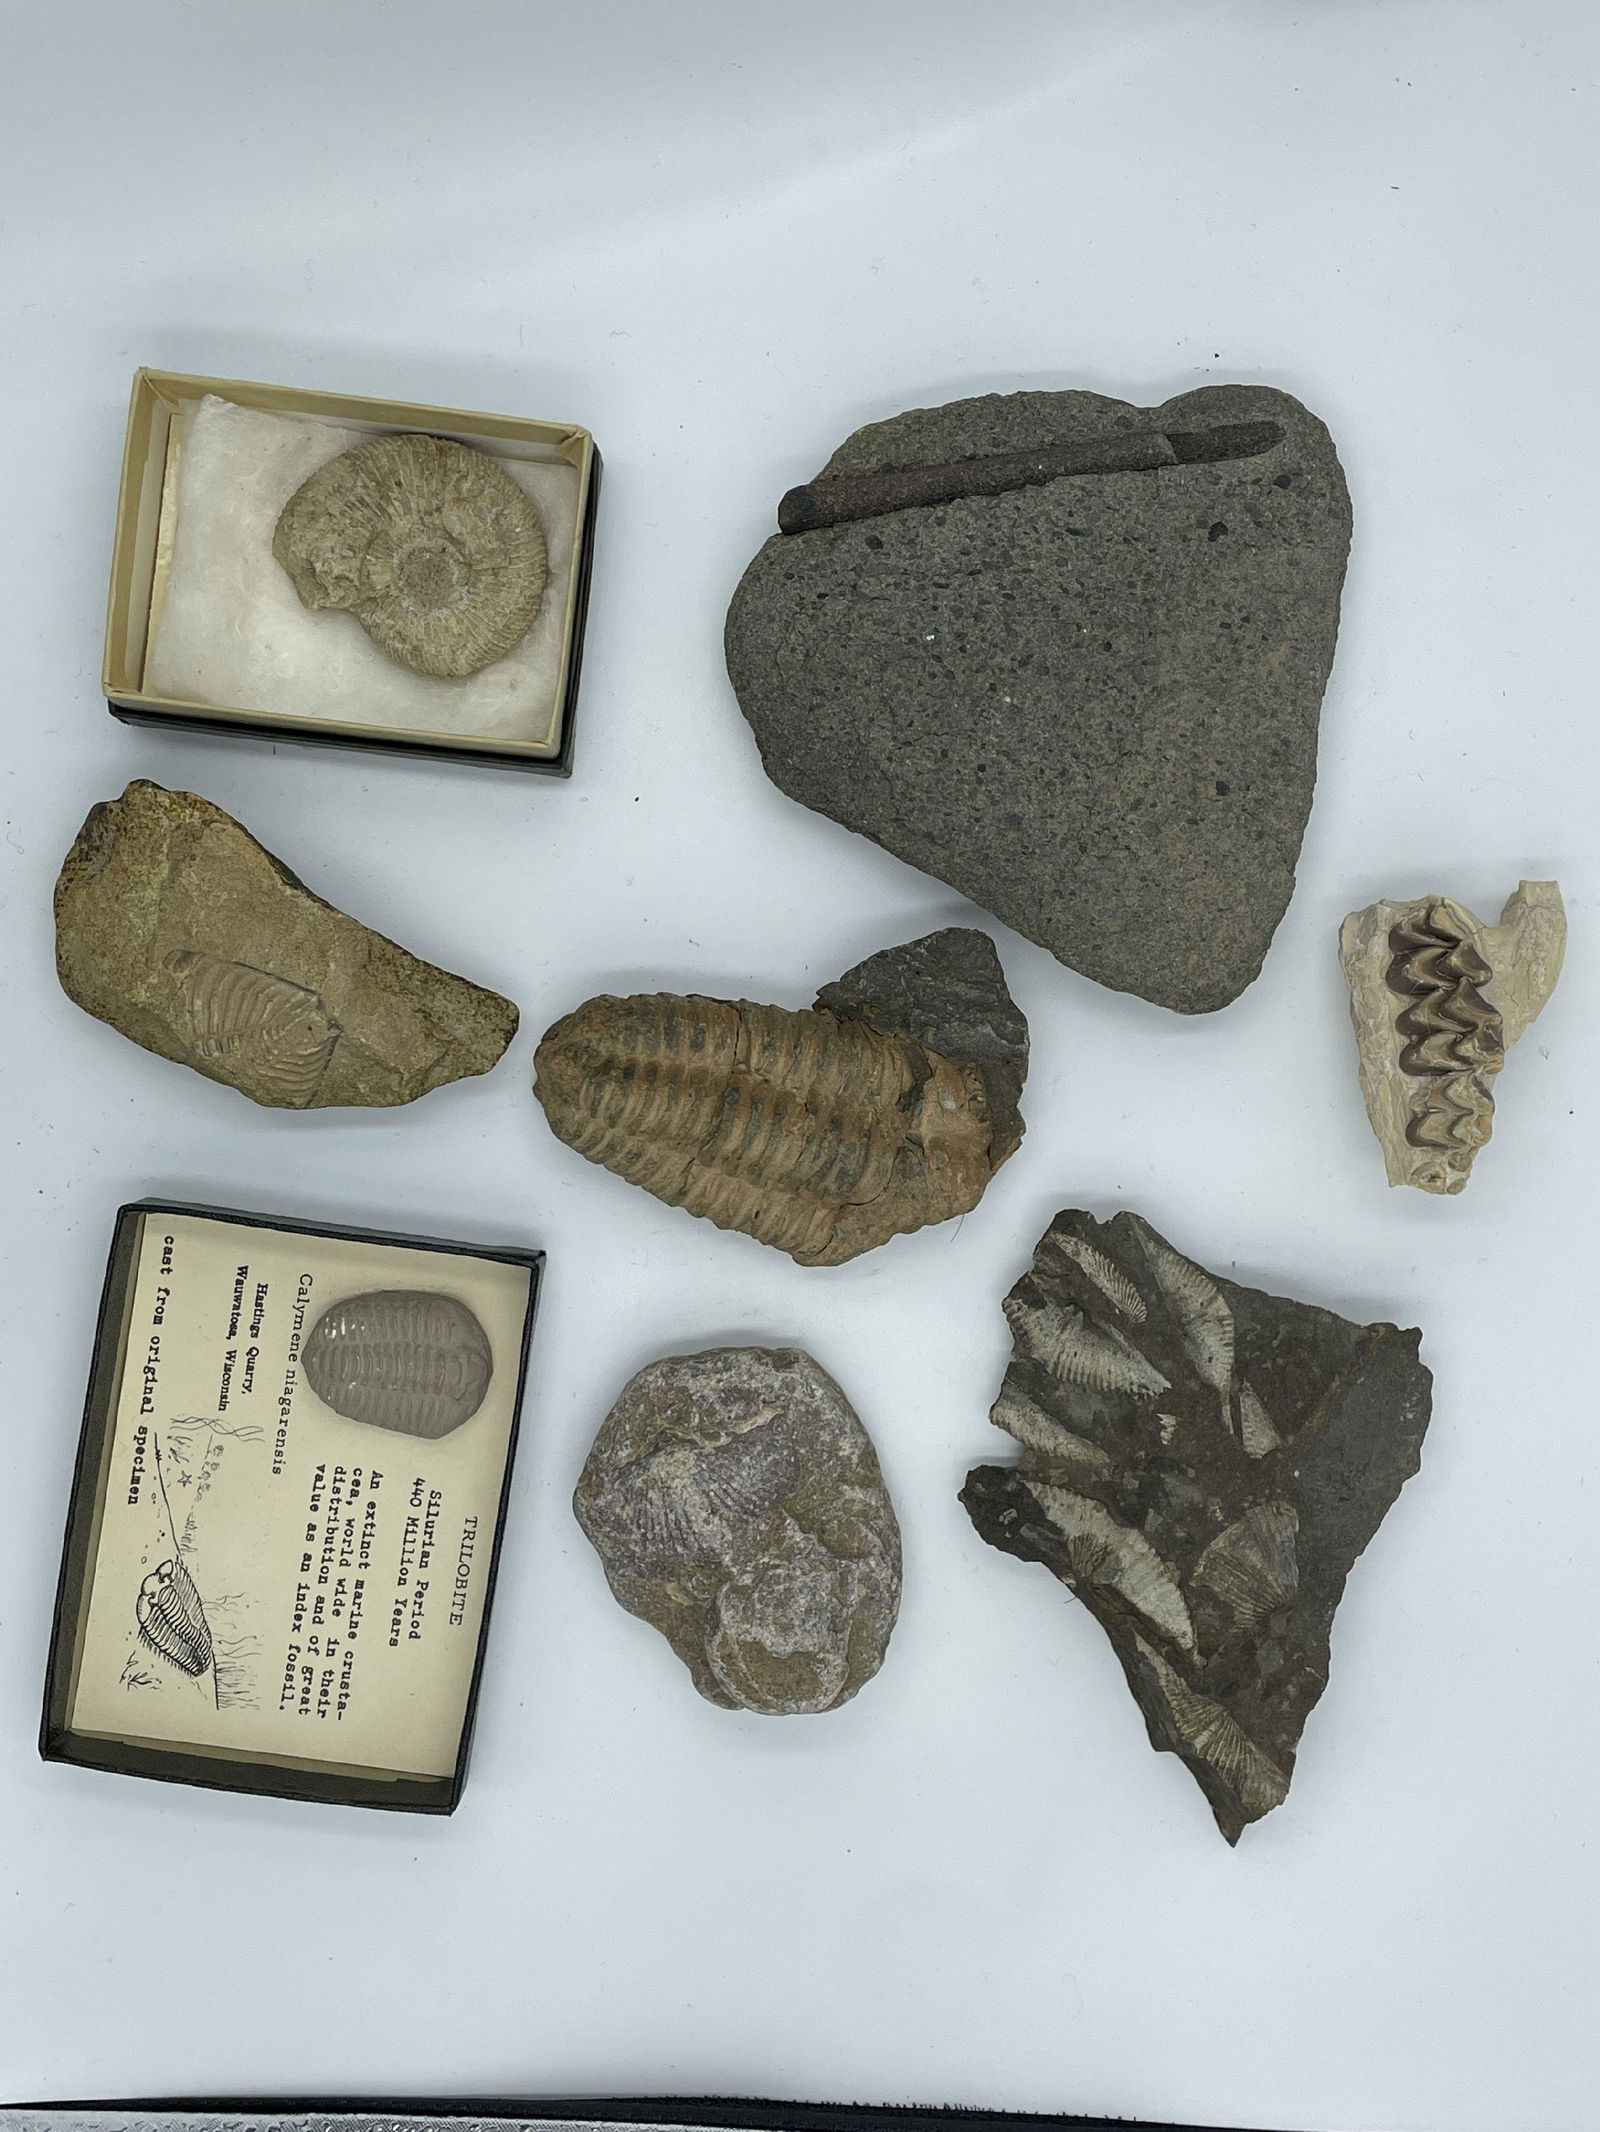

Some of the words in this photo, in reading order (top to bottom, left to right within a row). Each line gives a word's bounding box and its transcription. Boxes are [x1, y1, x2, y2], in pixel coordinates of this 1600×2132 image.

[161, 1235, 174, 1275] cast
[153, 1287, 170, 1325] from
[226, 1265, 249, 1340] Wauwatosa,
[250, 1283, 268, 1339] Hastings
[289, 1273, 313, 1362] Calymene
[140, 1336, 160, 1415] original
[218, 1349, 237, 1411] Wisconsin
[241, 1347, 260, 1395] Quarry,
[272, 1369, 297, 1475] niagarensis
[128, 1426, 148, 1504] specimen
[310, 1464, 326, 1512] value
[345, 1467, 363, 1505] cea,
[370, 1471, 384, 1490] An
[410, 1478, 425, 1508] 440
[305, 1523, 317, 1542] as
[318, 1466, 347, 1584] distribution
[339, 1518, 355, 1567] world
[359, 1501, 377, 1569] extinct
[420, 1490, 442, 1569] Silurian
[301, 1553, 312, 1572] an
[398, 1516, 420, 1586] Million
[449, 1516, 478, 1626] TRILOBITE
[292, 1583, 310, 1632] index
[312, 1595, 325, 1625] and
[332, 1578, 347, 1617] wide
[348, 1579, 365, 1639] marine
[409, 1580, 429, 1640] Period
[308, 1635, 320, 1655] of
[326, 1638, 340, 1656] in
[389, 1598, 408, 1647] Years
[279, 1644, 301, 1710] fossil.
[299, 1666, 314, 1715] great
[317, 1670, 335, 1718] their
[337, 1650, 354, 1721] crusta-
